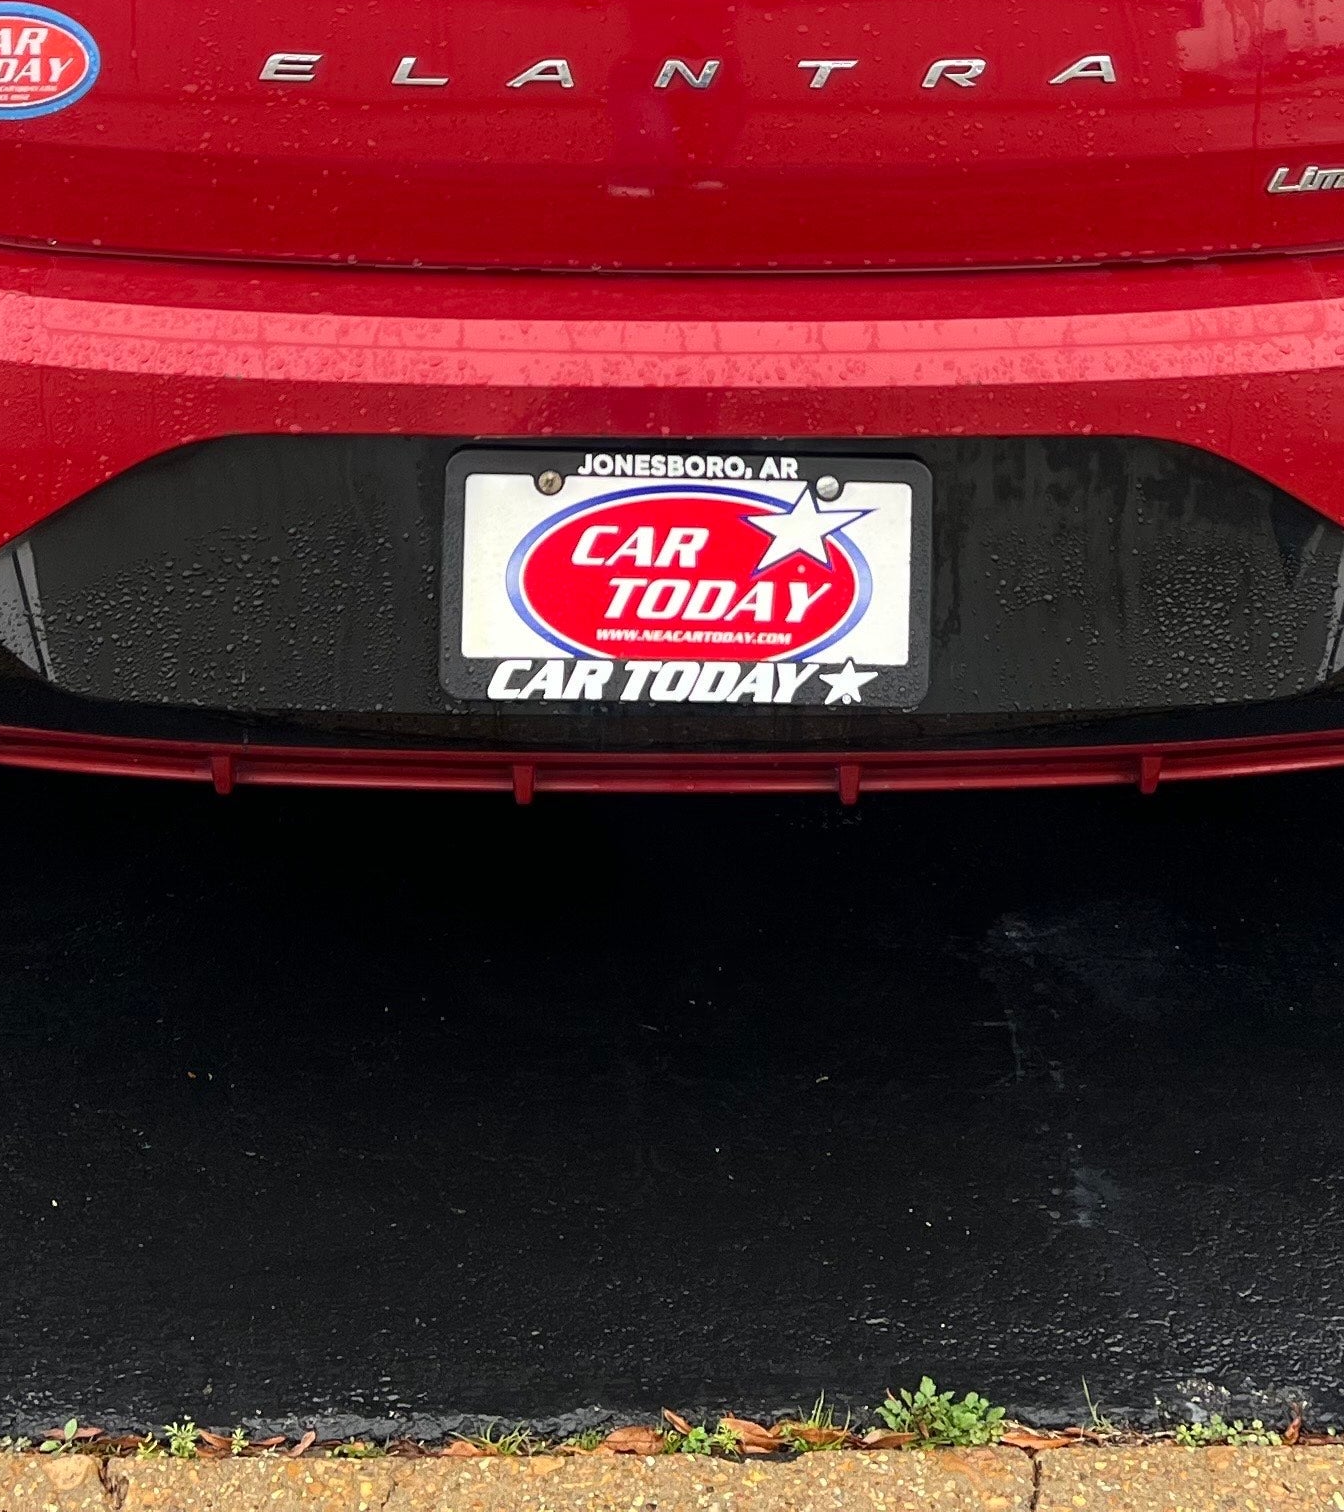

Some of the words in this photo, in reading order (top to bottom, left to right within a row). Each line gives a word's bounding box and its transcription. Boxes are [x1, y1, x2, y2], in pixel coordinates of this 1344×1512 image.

[259, 52, 1116, 89] ELANTRA
[578, 453, 753, 480] JONESBORO,
[759, 456, 798, 480] AR
[571, 525, 710, 568] CAR
[604, 577, 832, 623] TODAY
[596, 629, 792, 645] WWW.NEACARTODAY.COM
[487, 659, 618, 701] CAR
[619, 660, 820, 705] TODAY
